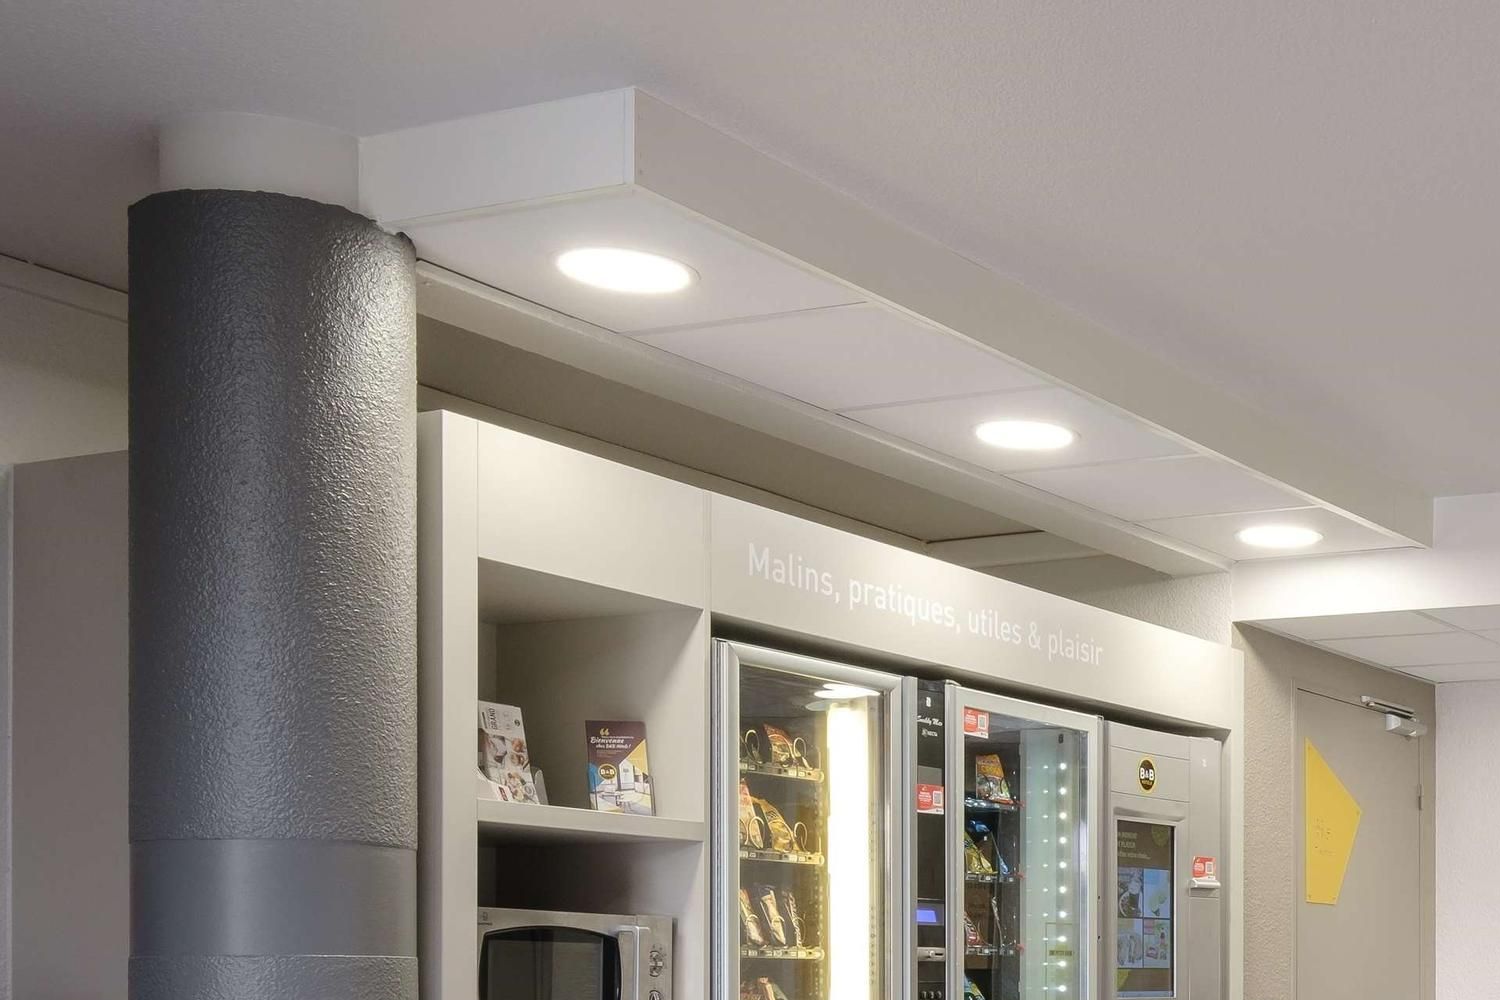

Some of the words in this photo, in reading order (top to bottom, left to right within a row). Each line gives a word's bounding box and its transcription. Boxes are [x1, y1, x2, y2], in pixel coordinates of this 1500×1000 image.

[748, 543, 841, 605] Malins,
[849, 578, 961, 635] pratiques,
[968, 608, 1023, 645] utiles
[1028, 621, 1042, 650] &
[1048, 628, 1104, 665] plaisir
[1140, 767, 1154, 781] B&B
